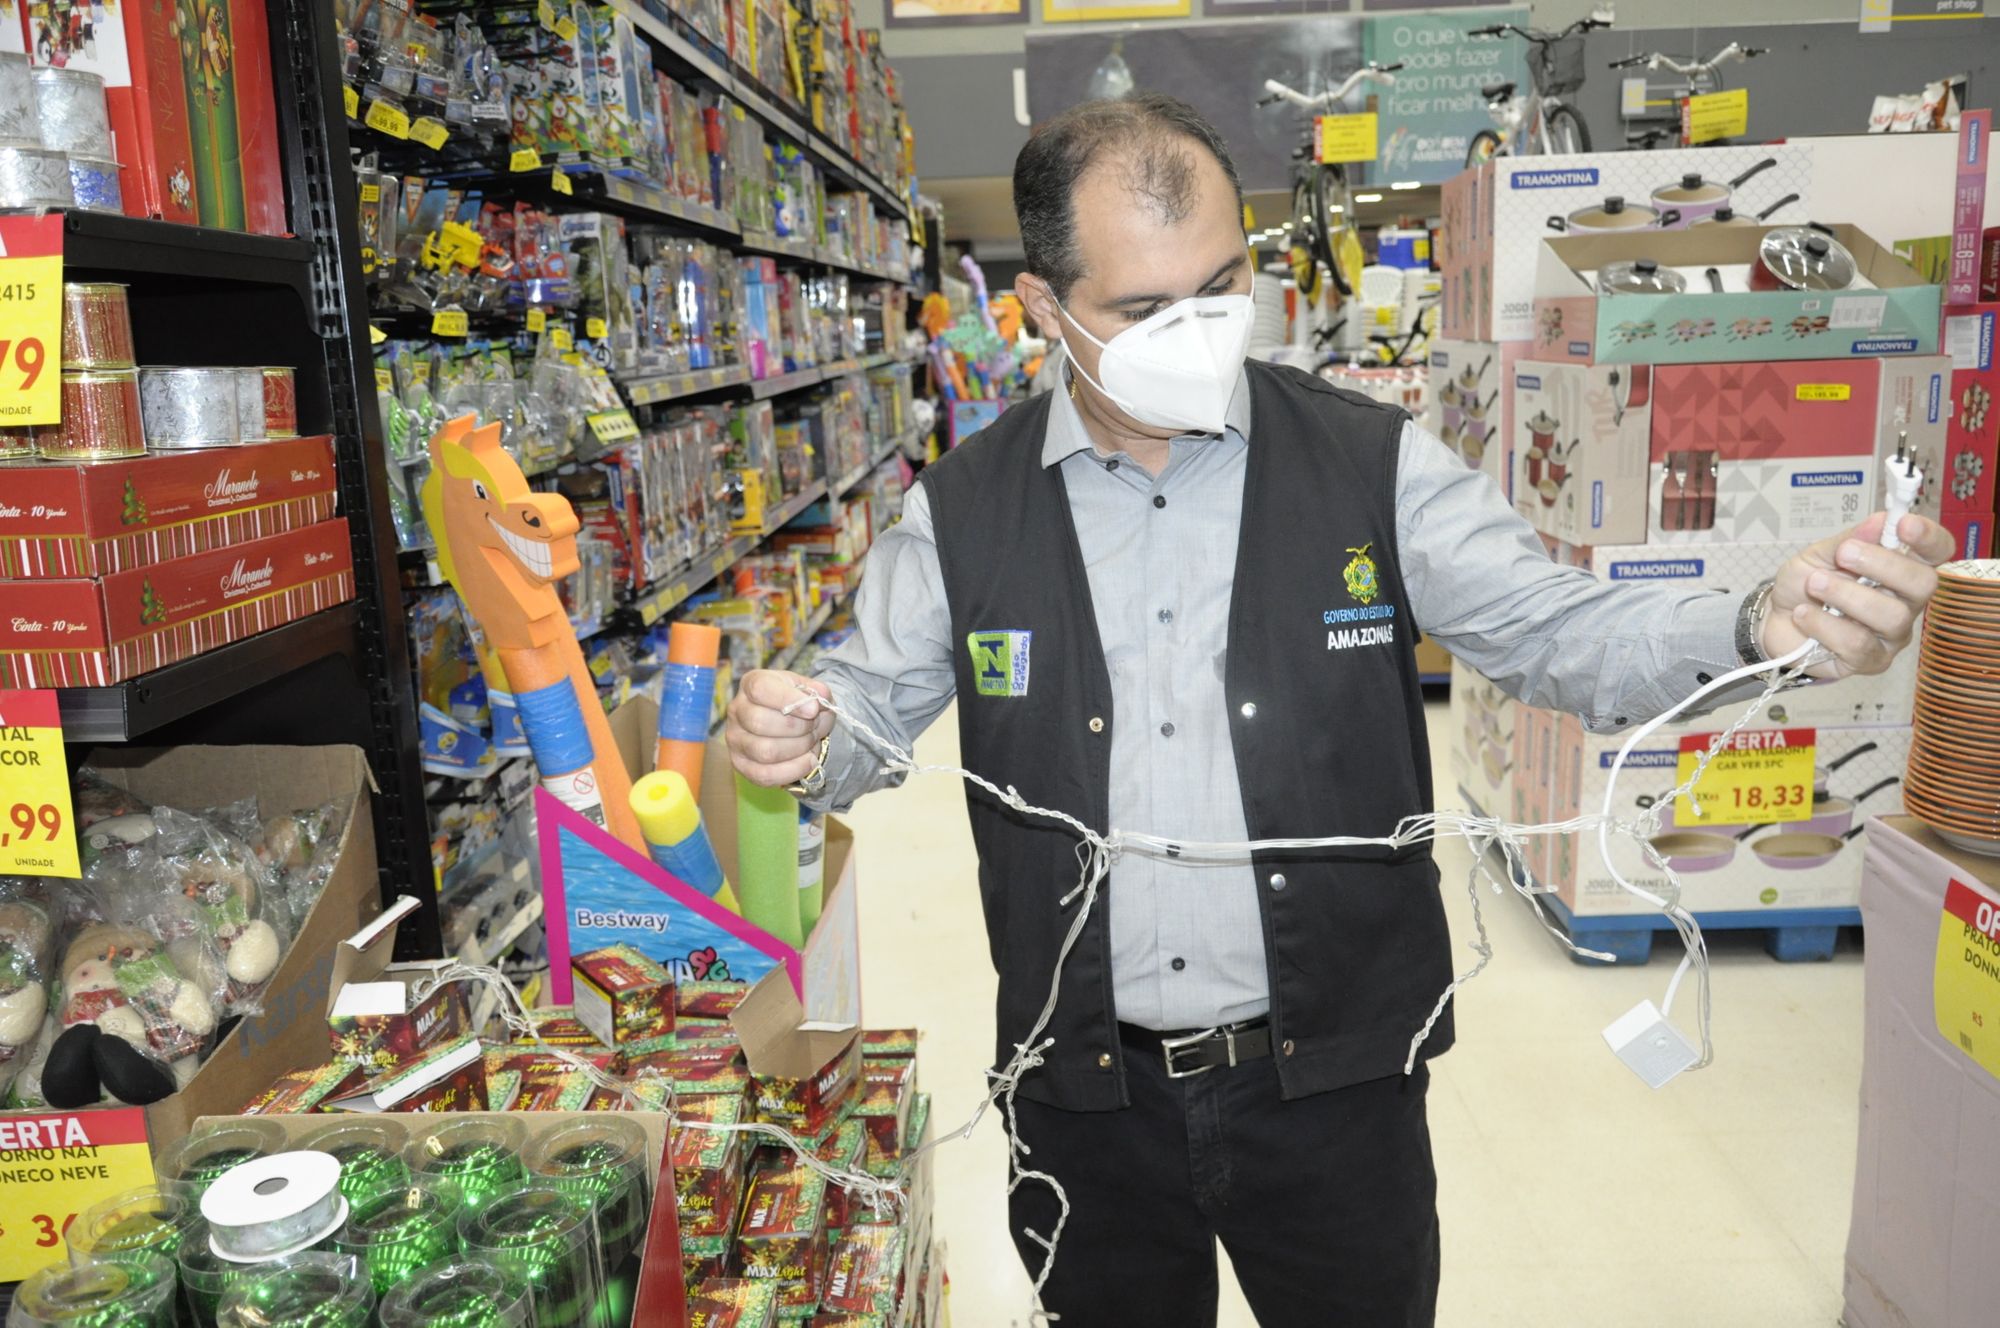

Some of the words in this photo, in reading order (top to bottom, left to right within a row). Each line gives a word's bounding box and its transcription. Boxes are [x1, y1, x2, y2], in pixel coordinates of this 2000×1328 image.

[1416, 28, 1455, 47] que
[1516, 172, 1594, 187] TRAMONTINA
[0, 283, 36, 301] 415
[1856, 341, 1913, 352] TRAMONTINA
[1980, 316, 1993, 368] TRAMONTINA
[1795, 474, 1859, 486] TRAMONTINA
[31, 505, 46, 517] 10
[1615, 564, 1699, 578] TRAMONTINA
[11, 617, 43, 632] Cinta
[52, 620, 66, 632] 10
[1323, 607, 1359, 625] GOVERNO
[1359, 607, 1369, 620] DO
[1327, 624, 1394, 650] AMAZONAS
[1732, 784, 1805, 810] 18,33
[15, 857, 55, 867] UNIDADE
[577, 909, 668, 932] Bestway
[62, 1144, 100, 1160] NAT
[0, 1168, 54, 1184] NECO
[60, 1164, 110, 1181] NEVE
